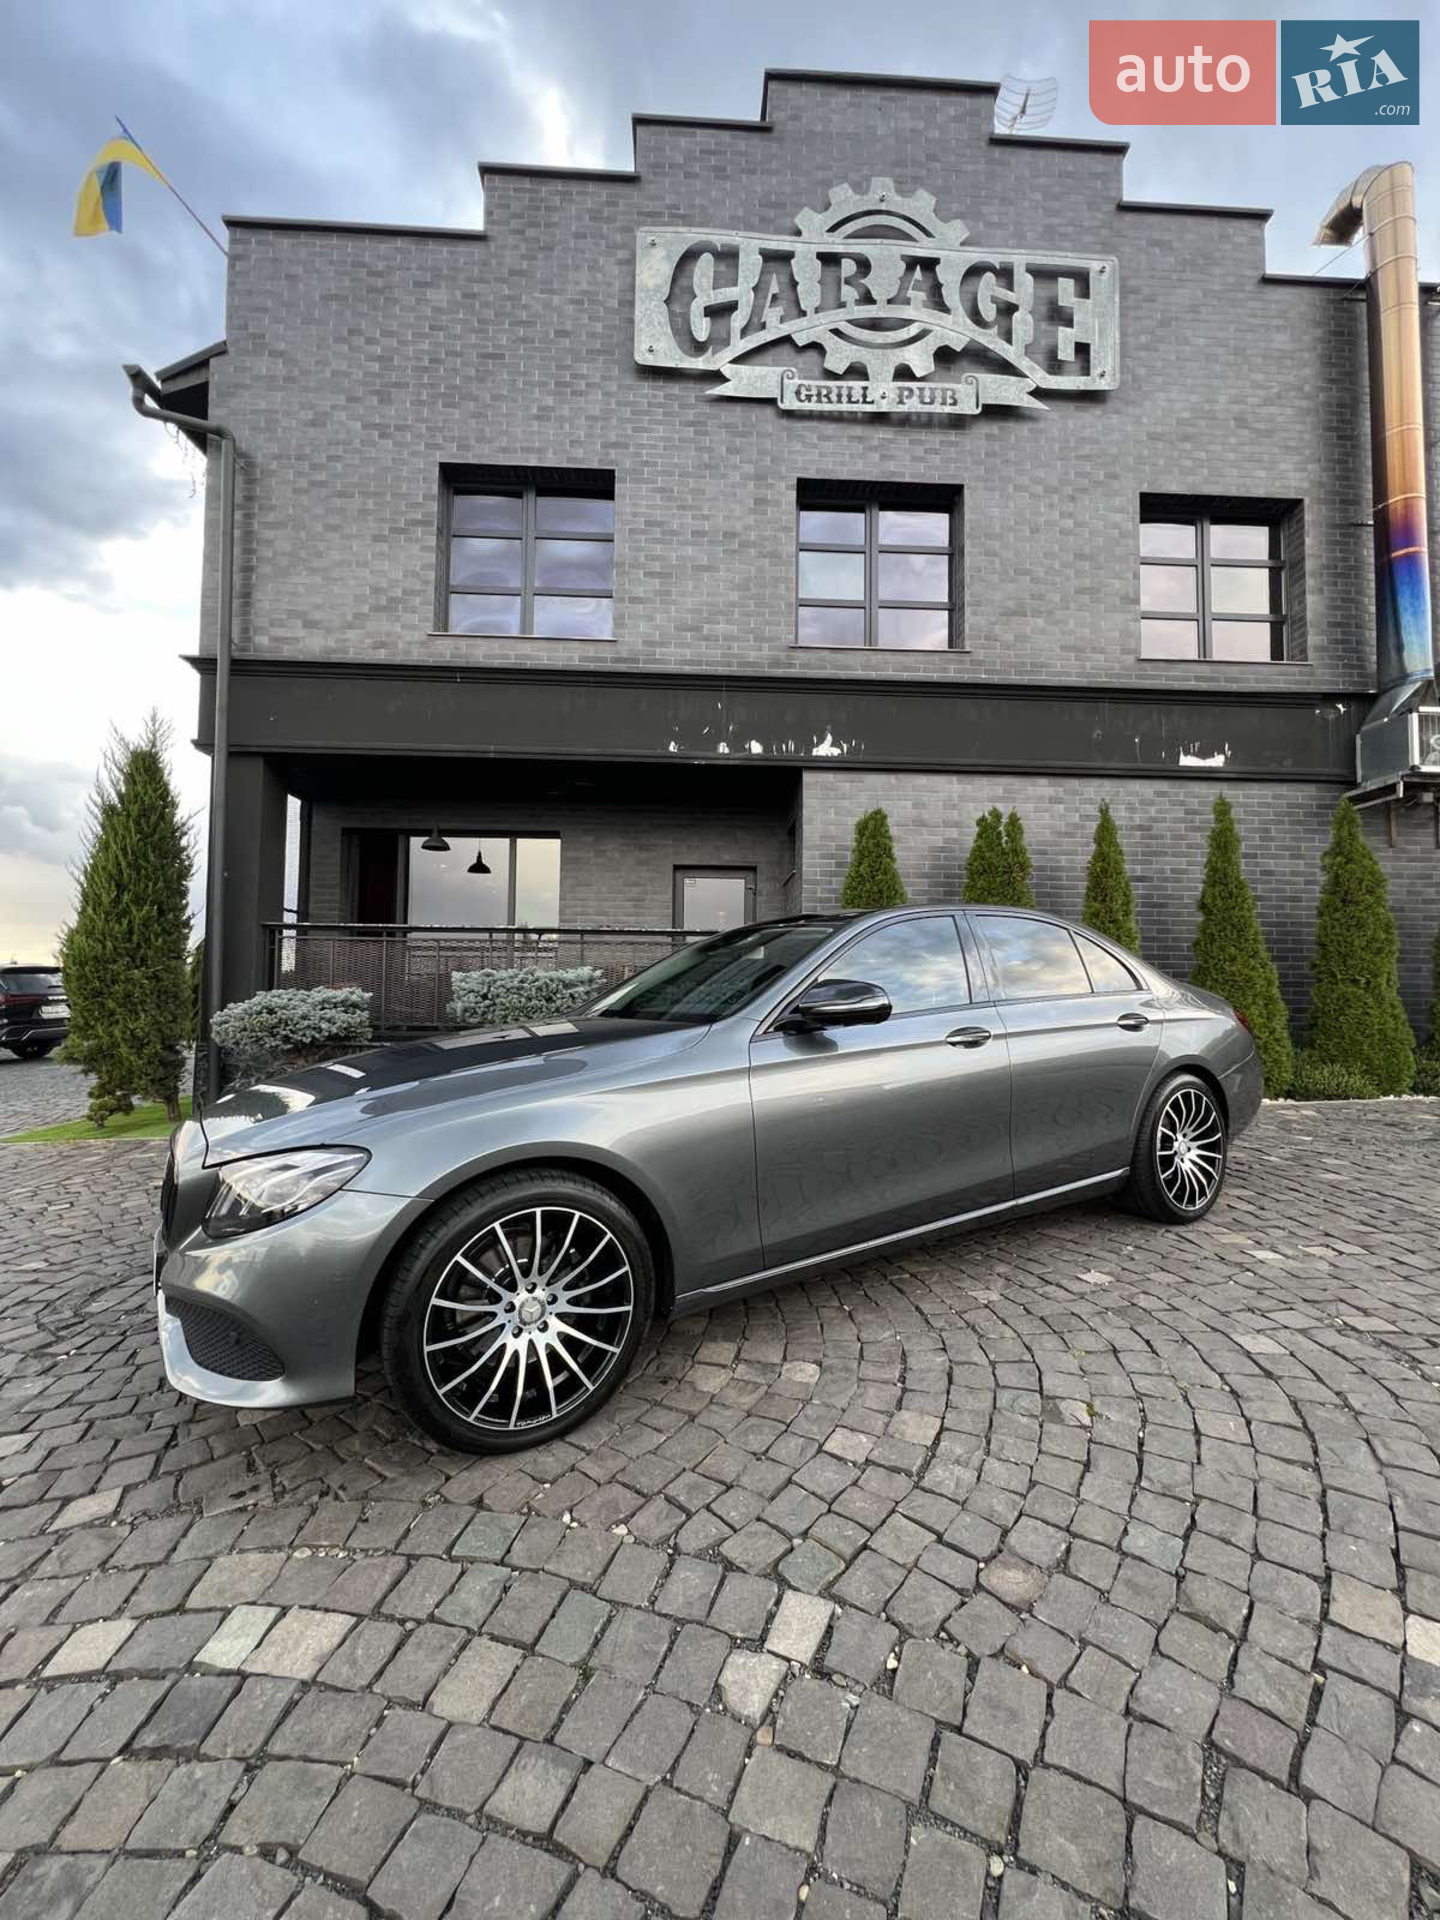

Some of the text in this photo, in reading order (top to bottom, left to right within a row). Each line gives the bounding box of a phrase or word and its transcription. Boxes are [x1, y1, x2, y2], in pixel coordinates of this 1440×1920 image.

[663, 240, 1092, 378] GARAGE
[794, 383, 959, 407] GRILL PUB
